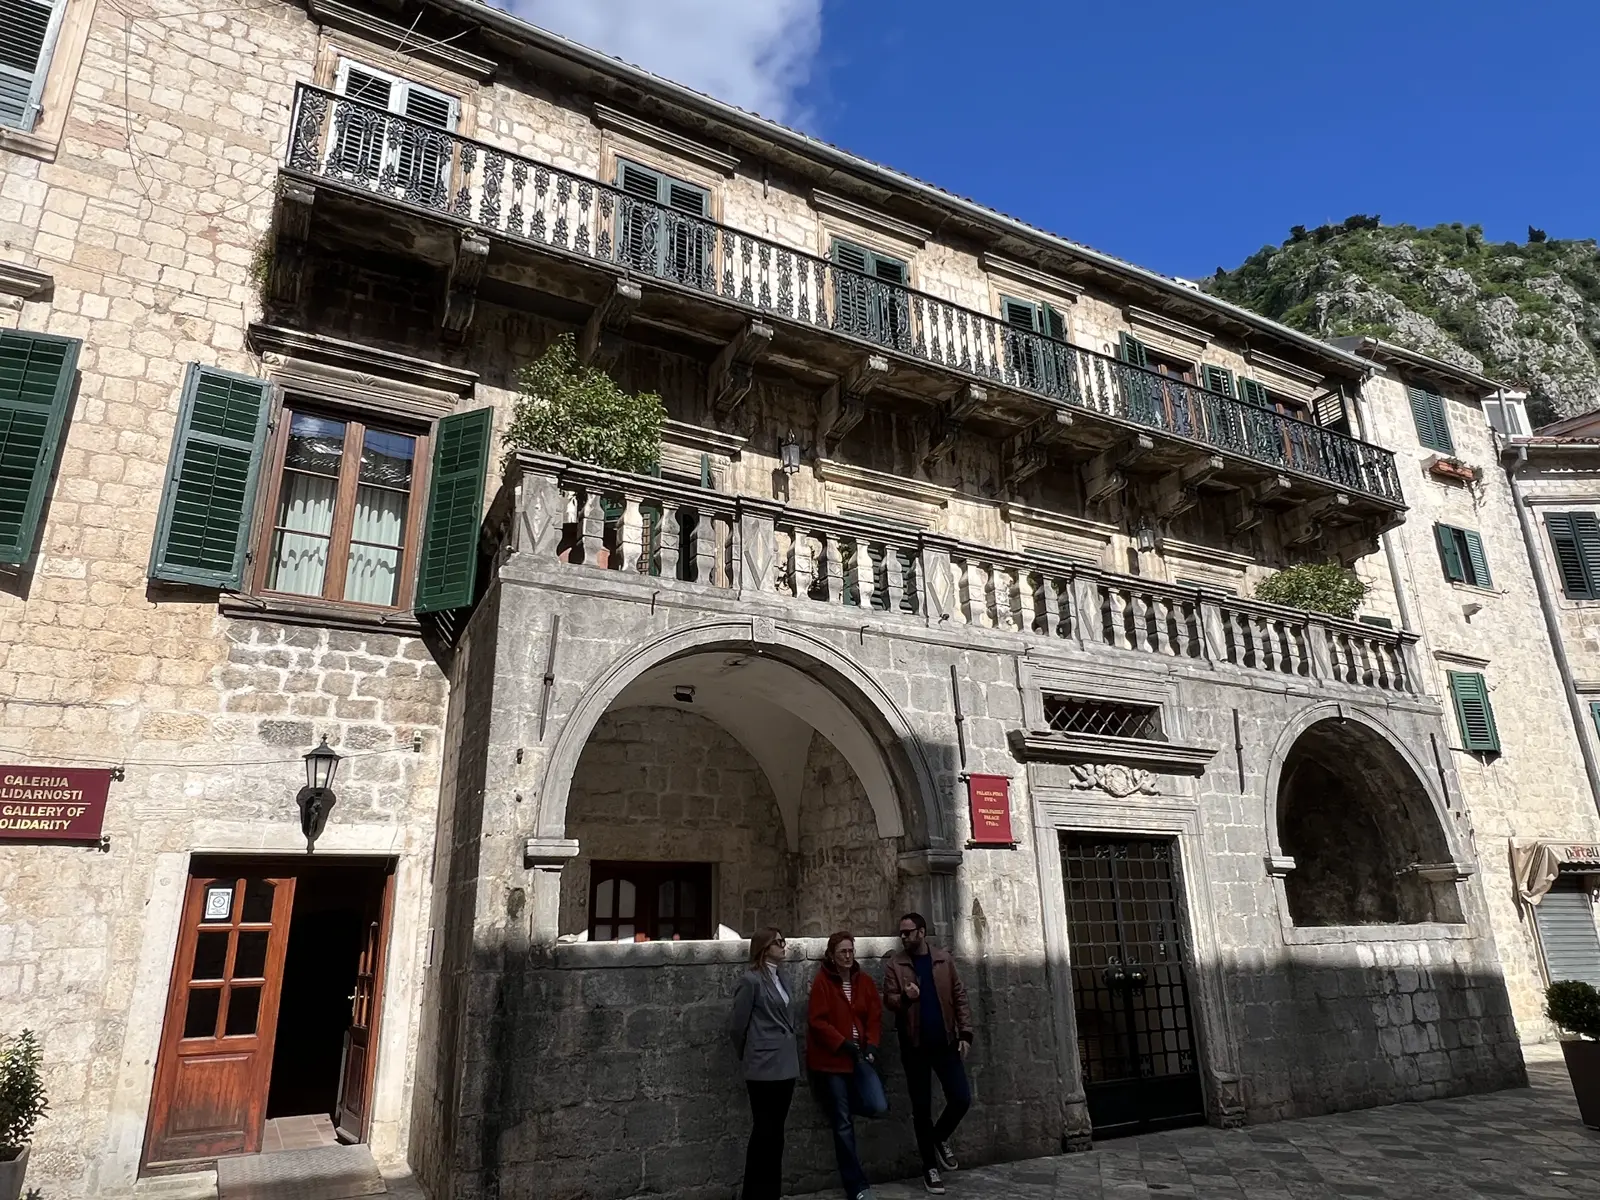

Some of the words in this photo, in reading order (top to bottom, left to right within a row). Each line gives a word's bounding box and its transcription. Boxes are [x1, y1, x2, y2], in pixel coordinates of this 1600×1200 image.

[4, 775, 69, 787] GALERIJA
[0, 788, 83, 800] LIDARNOSTI
[2, 805, 65, 817] GALLERY
[67, 807, 86, 817] OF
